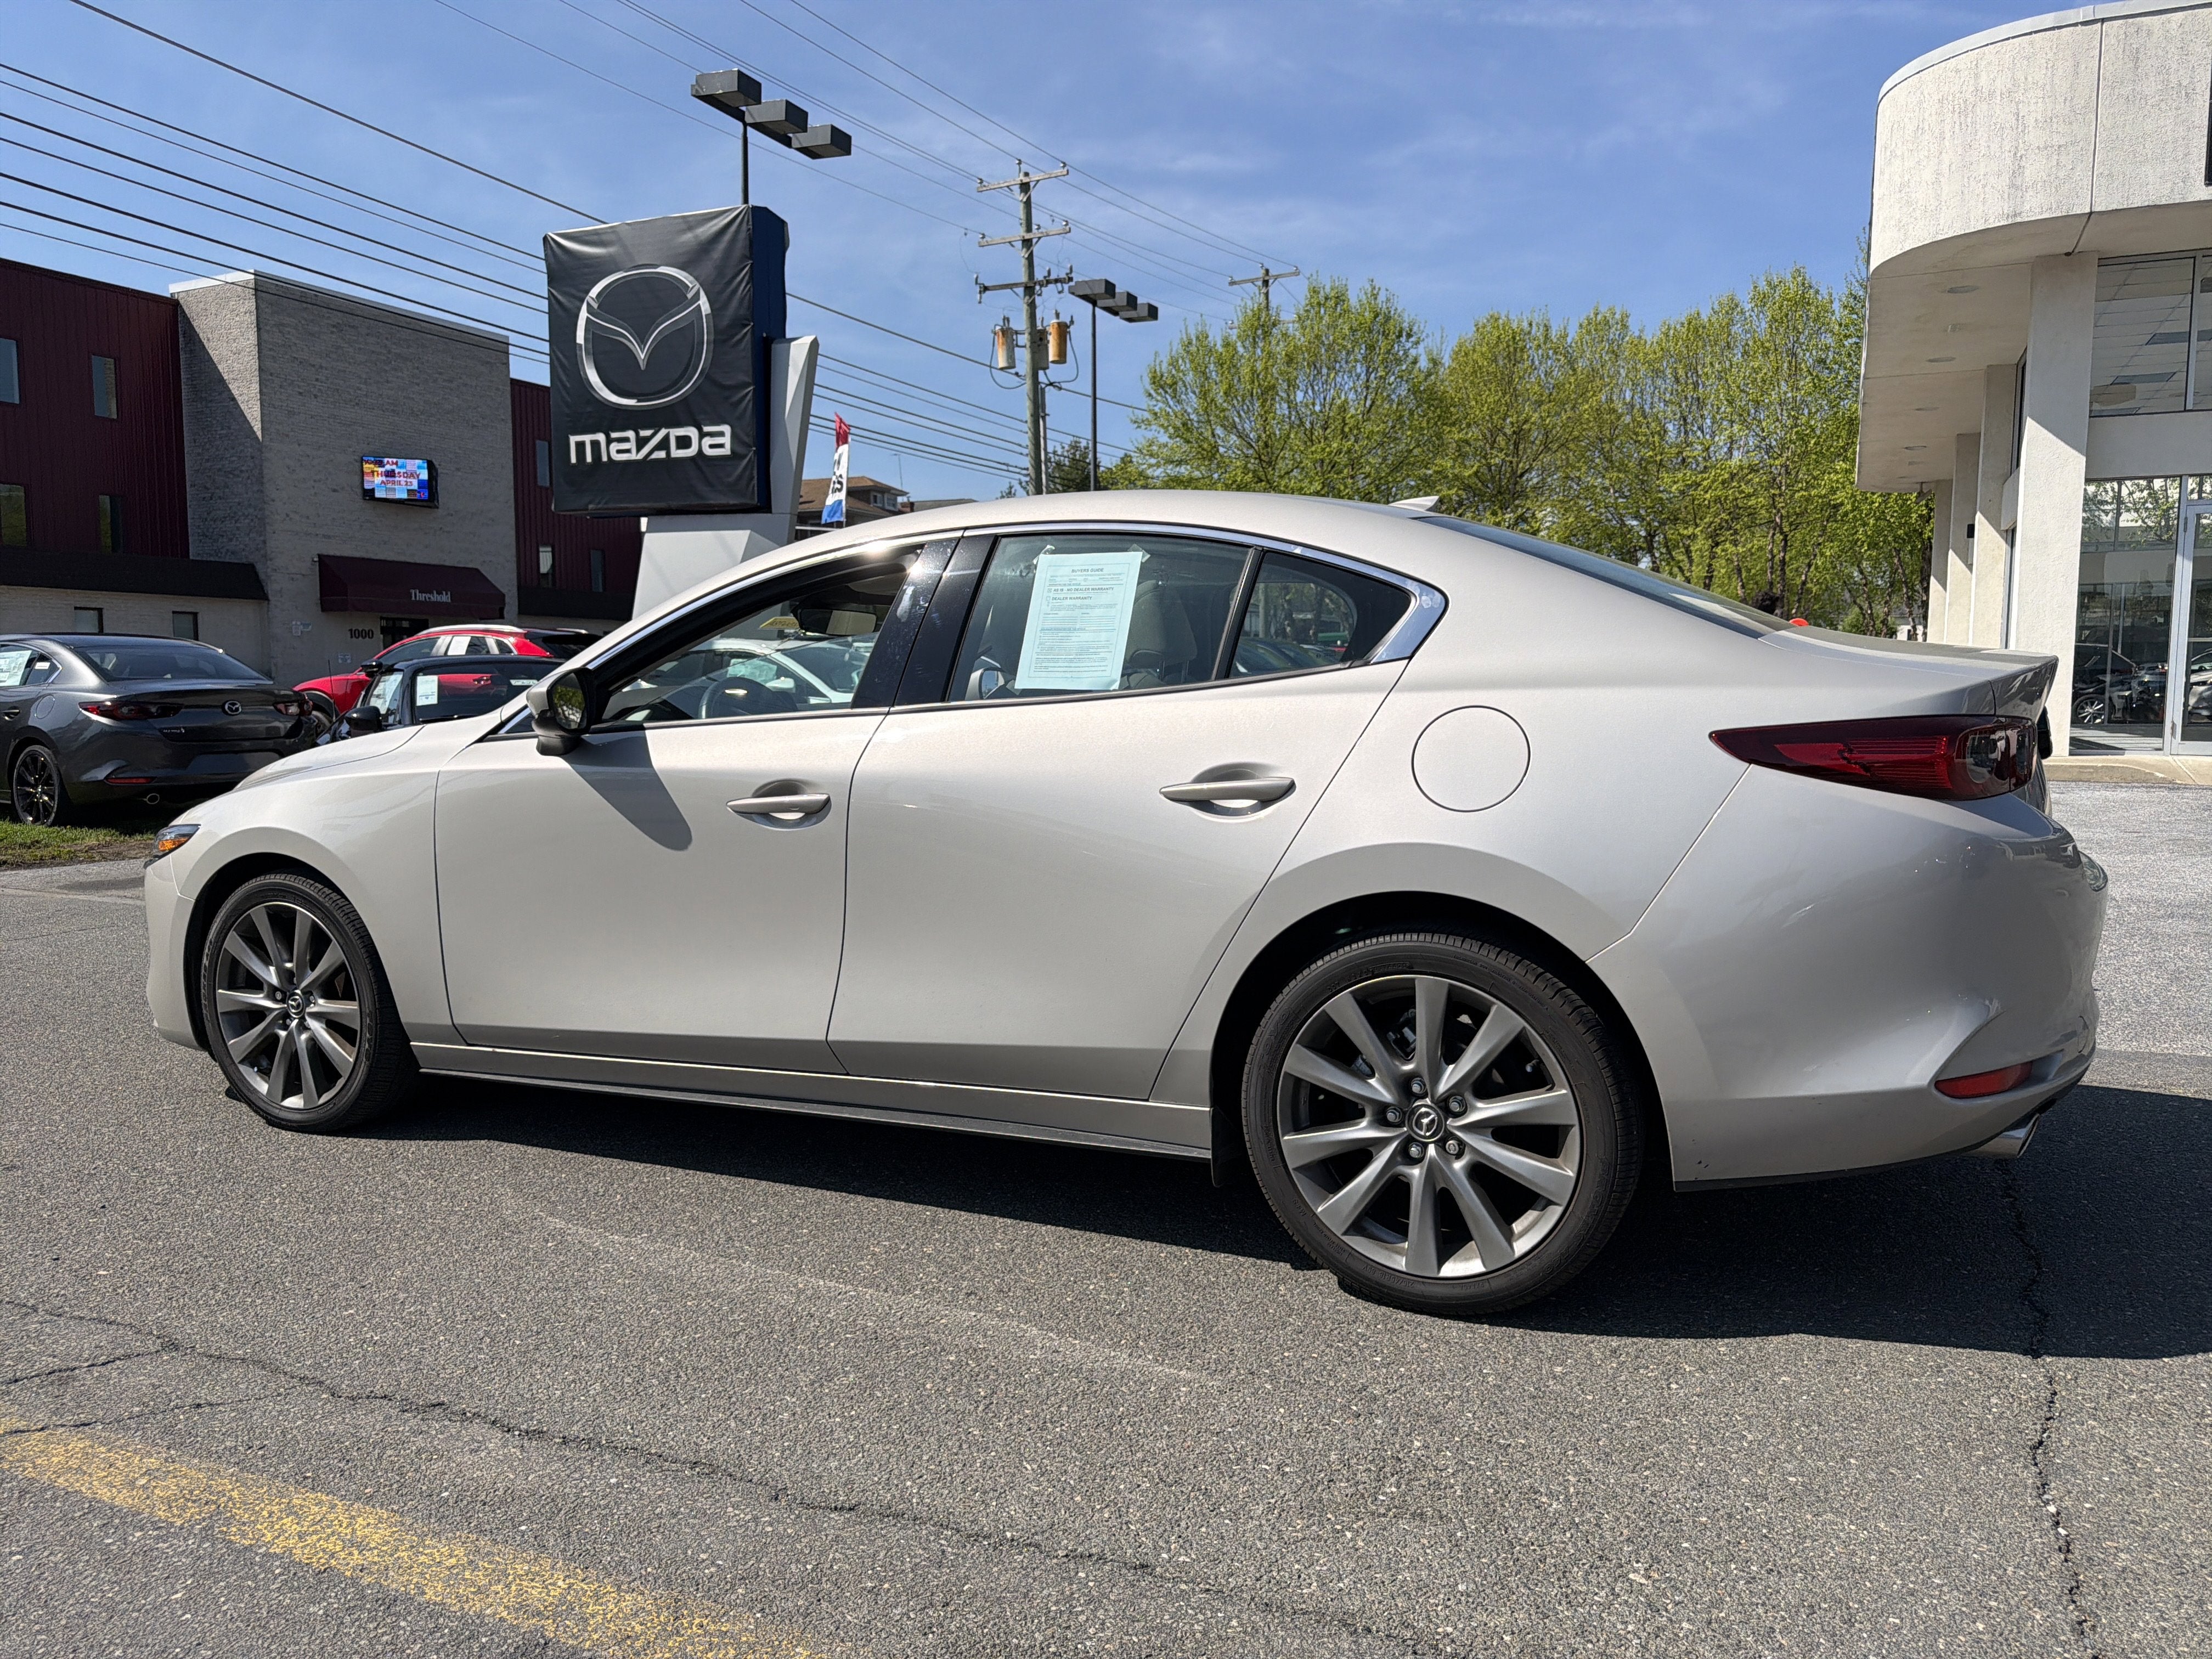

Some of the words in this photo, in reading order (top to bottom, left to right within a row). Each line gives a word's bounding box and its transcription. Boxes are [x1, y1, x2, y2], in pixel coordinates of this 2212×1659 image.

[371, 470, 421, 479] THURSDAY
[410, 589, 451, 602] Threshold
[348, 628, 374, 639] 1000
